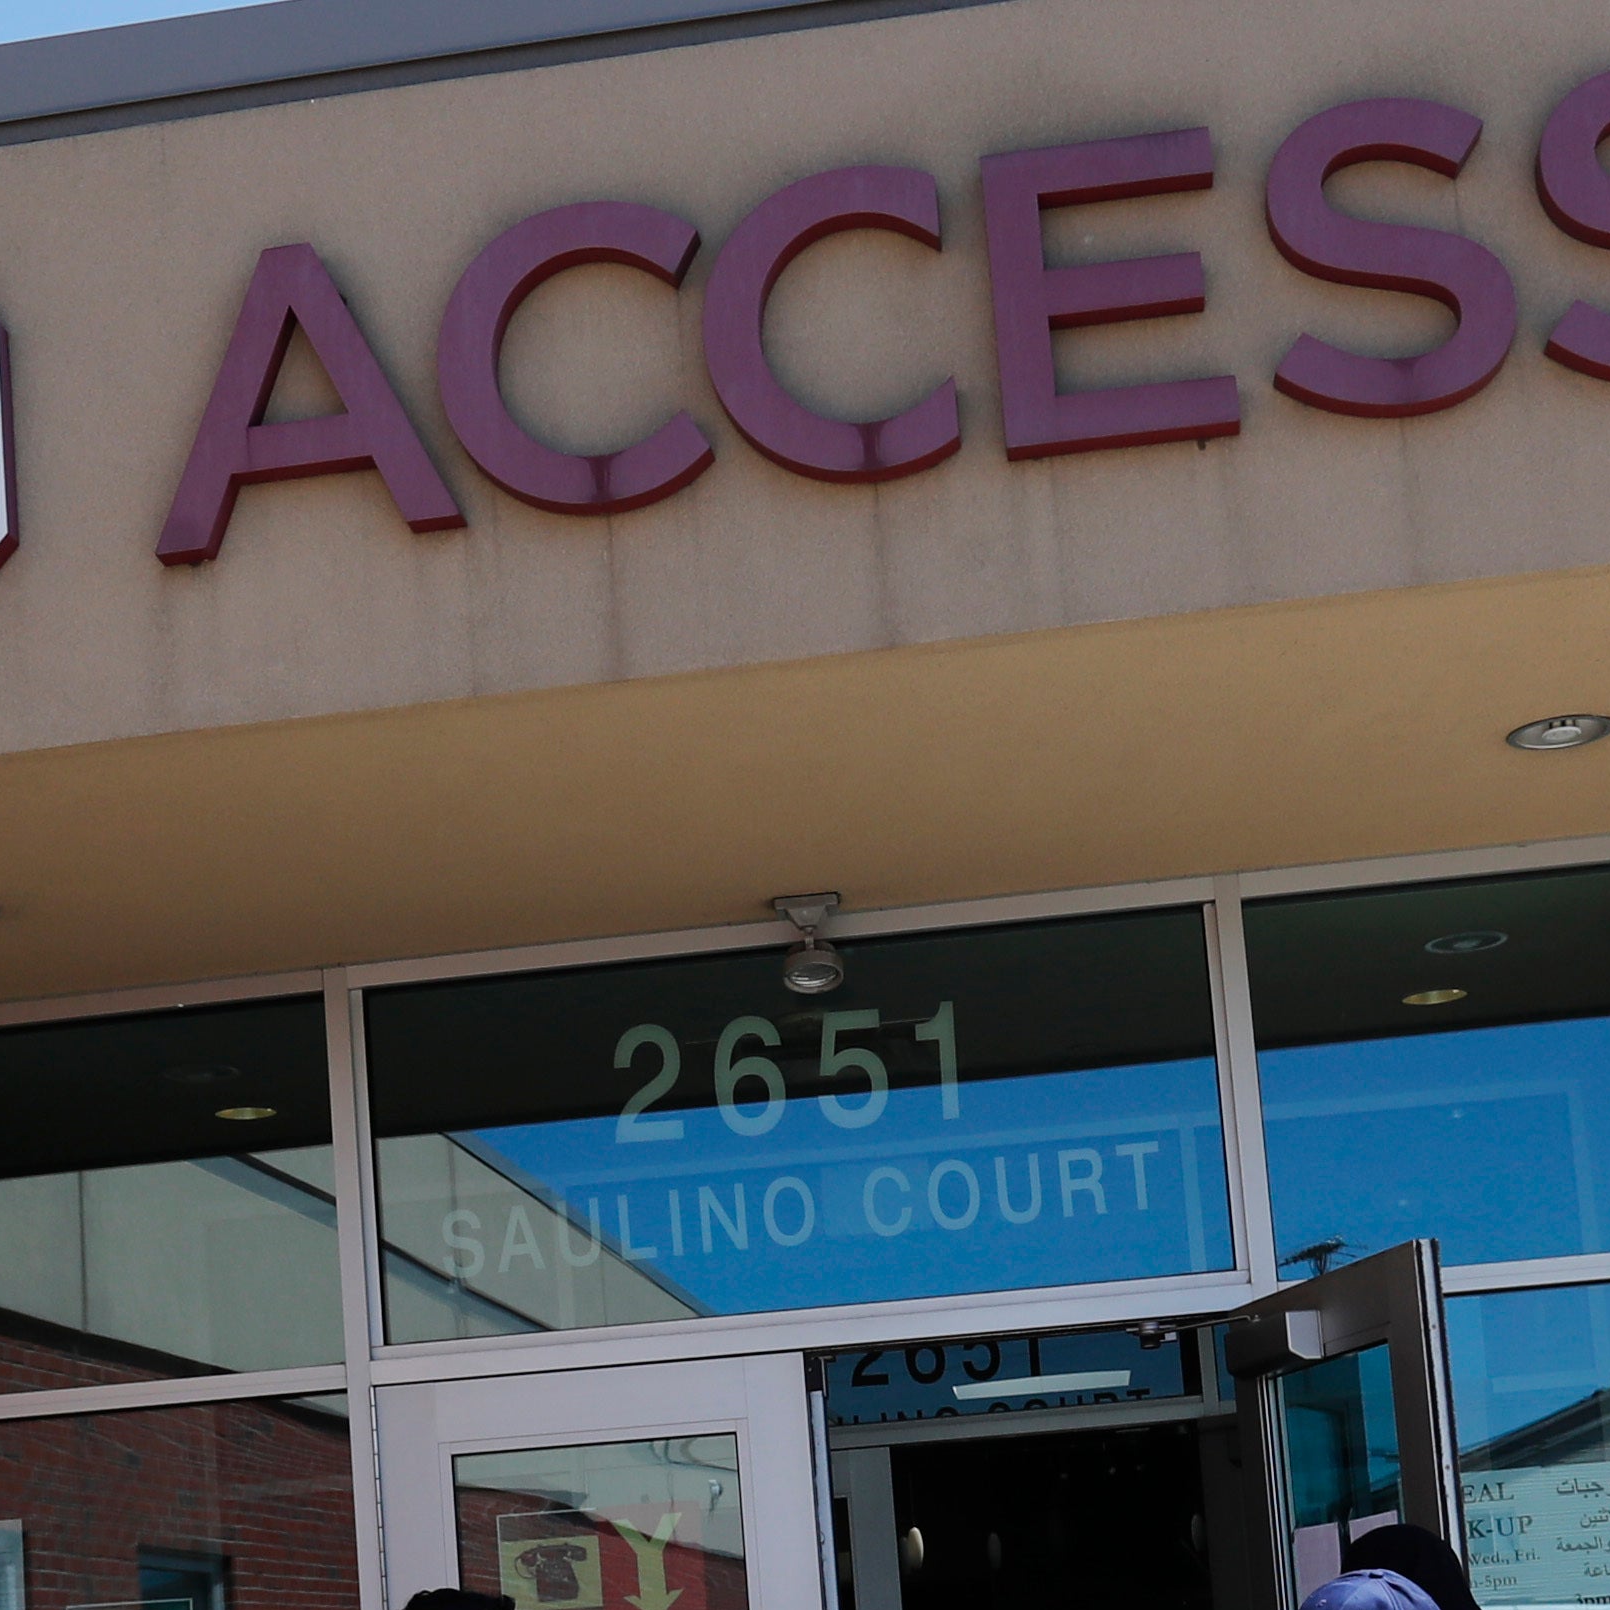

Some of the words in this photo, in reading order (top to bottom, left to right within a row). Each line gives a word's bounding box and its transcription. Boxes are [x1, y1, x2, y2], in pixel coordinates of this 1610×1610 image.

[613, 1000, 960, 1145] 2651
[442, 1175, 817, 1281] SAULINO
[862, 1140, 1161, 1238] COURT
[1462, 1482, 1514, 1504] EAL
[1467, 1515, 1533, 1540] K-UP
